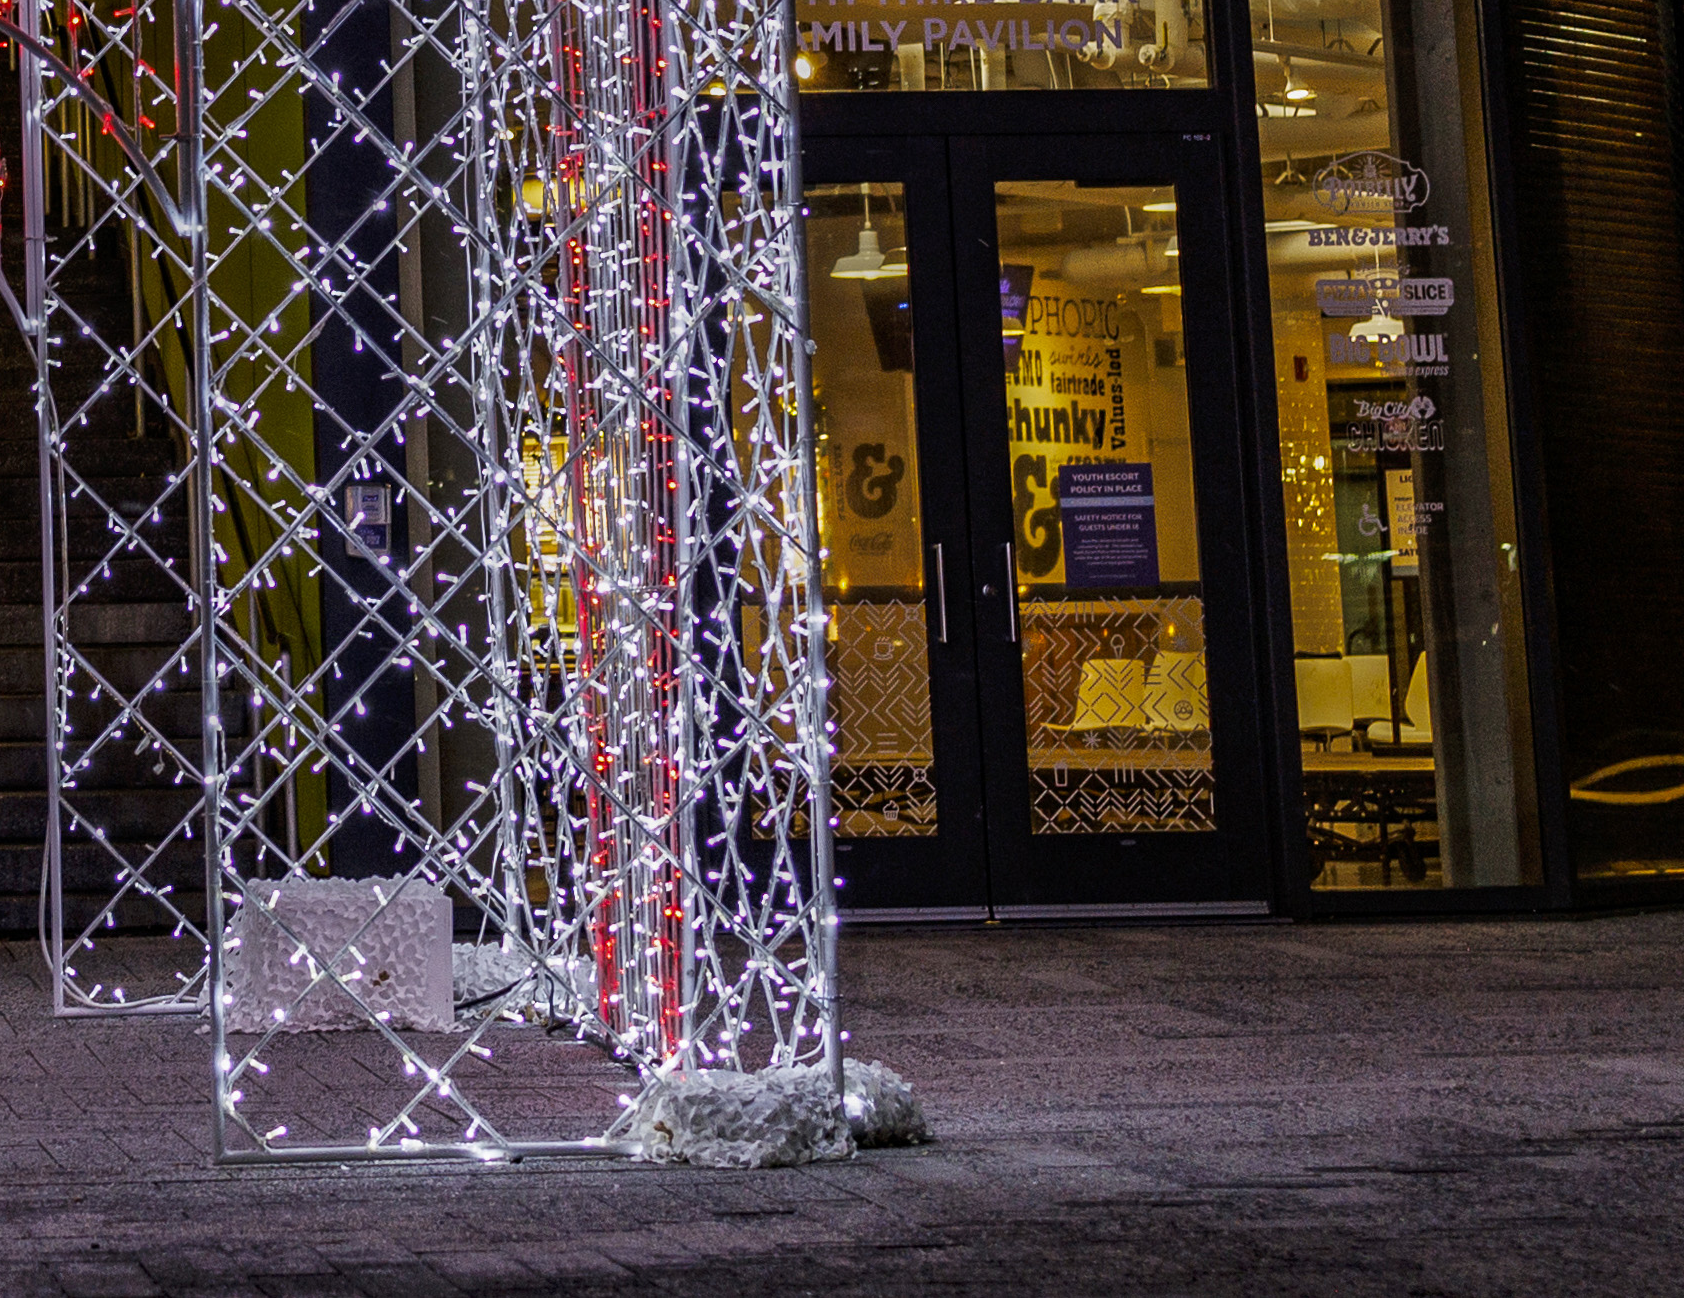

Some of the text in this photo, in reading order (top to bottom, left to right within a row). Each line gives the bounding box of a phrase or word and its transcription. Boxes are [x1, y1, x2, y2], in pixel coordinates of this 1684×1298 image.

[923, 17, 1123, 52] PAVILION
[1404, 284, 1446, 301] SLICE
[1329, 333, 1449, 363] BIG BOWL
[1051, 371, 1106, 396] fairtrade
[1347, 421, 1444, 452] CHICKEN
[1071, 472, 1139, 482] YOUTH ESCORT
[1070, 484, 1143, 494] POLICY IN PLACE
[1396, 502, 1444, 512] ELEVATOR
[1074, 513, 1143, 522] SAFETY NOTICE FOR
[1397, 514, 1433, 524] ACCESS
[1078, 524, 1106, 532] GUESTS
[1106, 523, 1131, 531] UNDER
[1397, 526, 1429, 536] INSIDE
